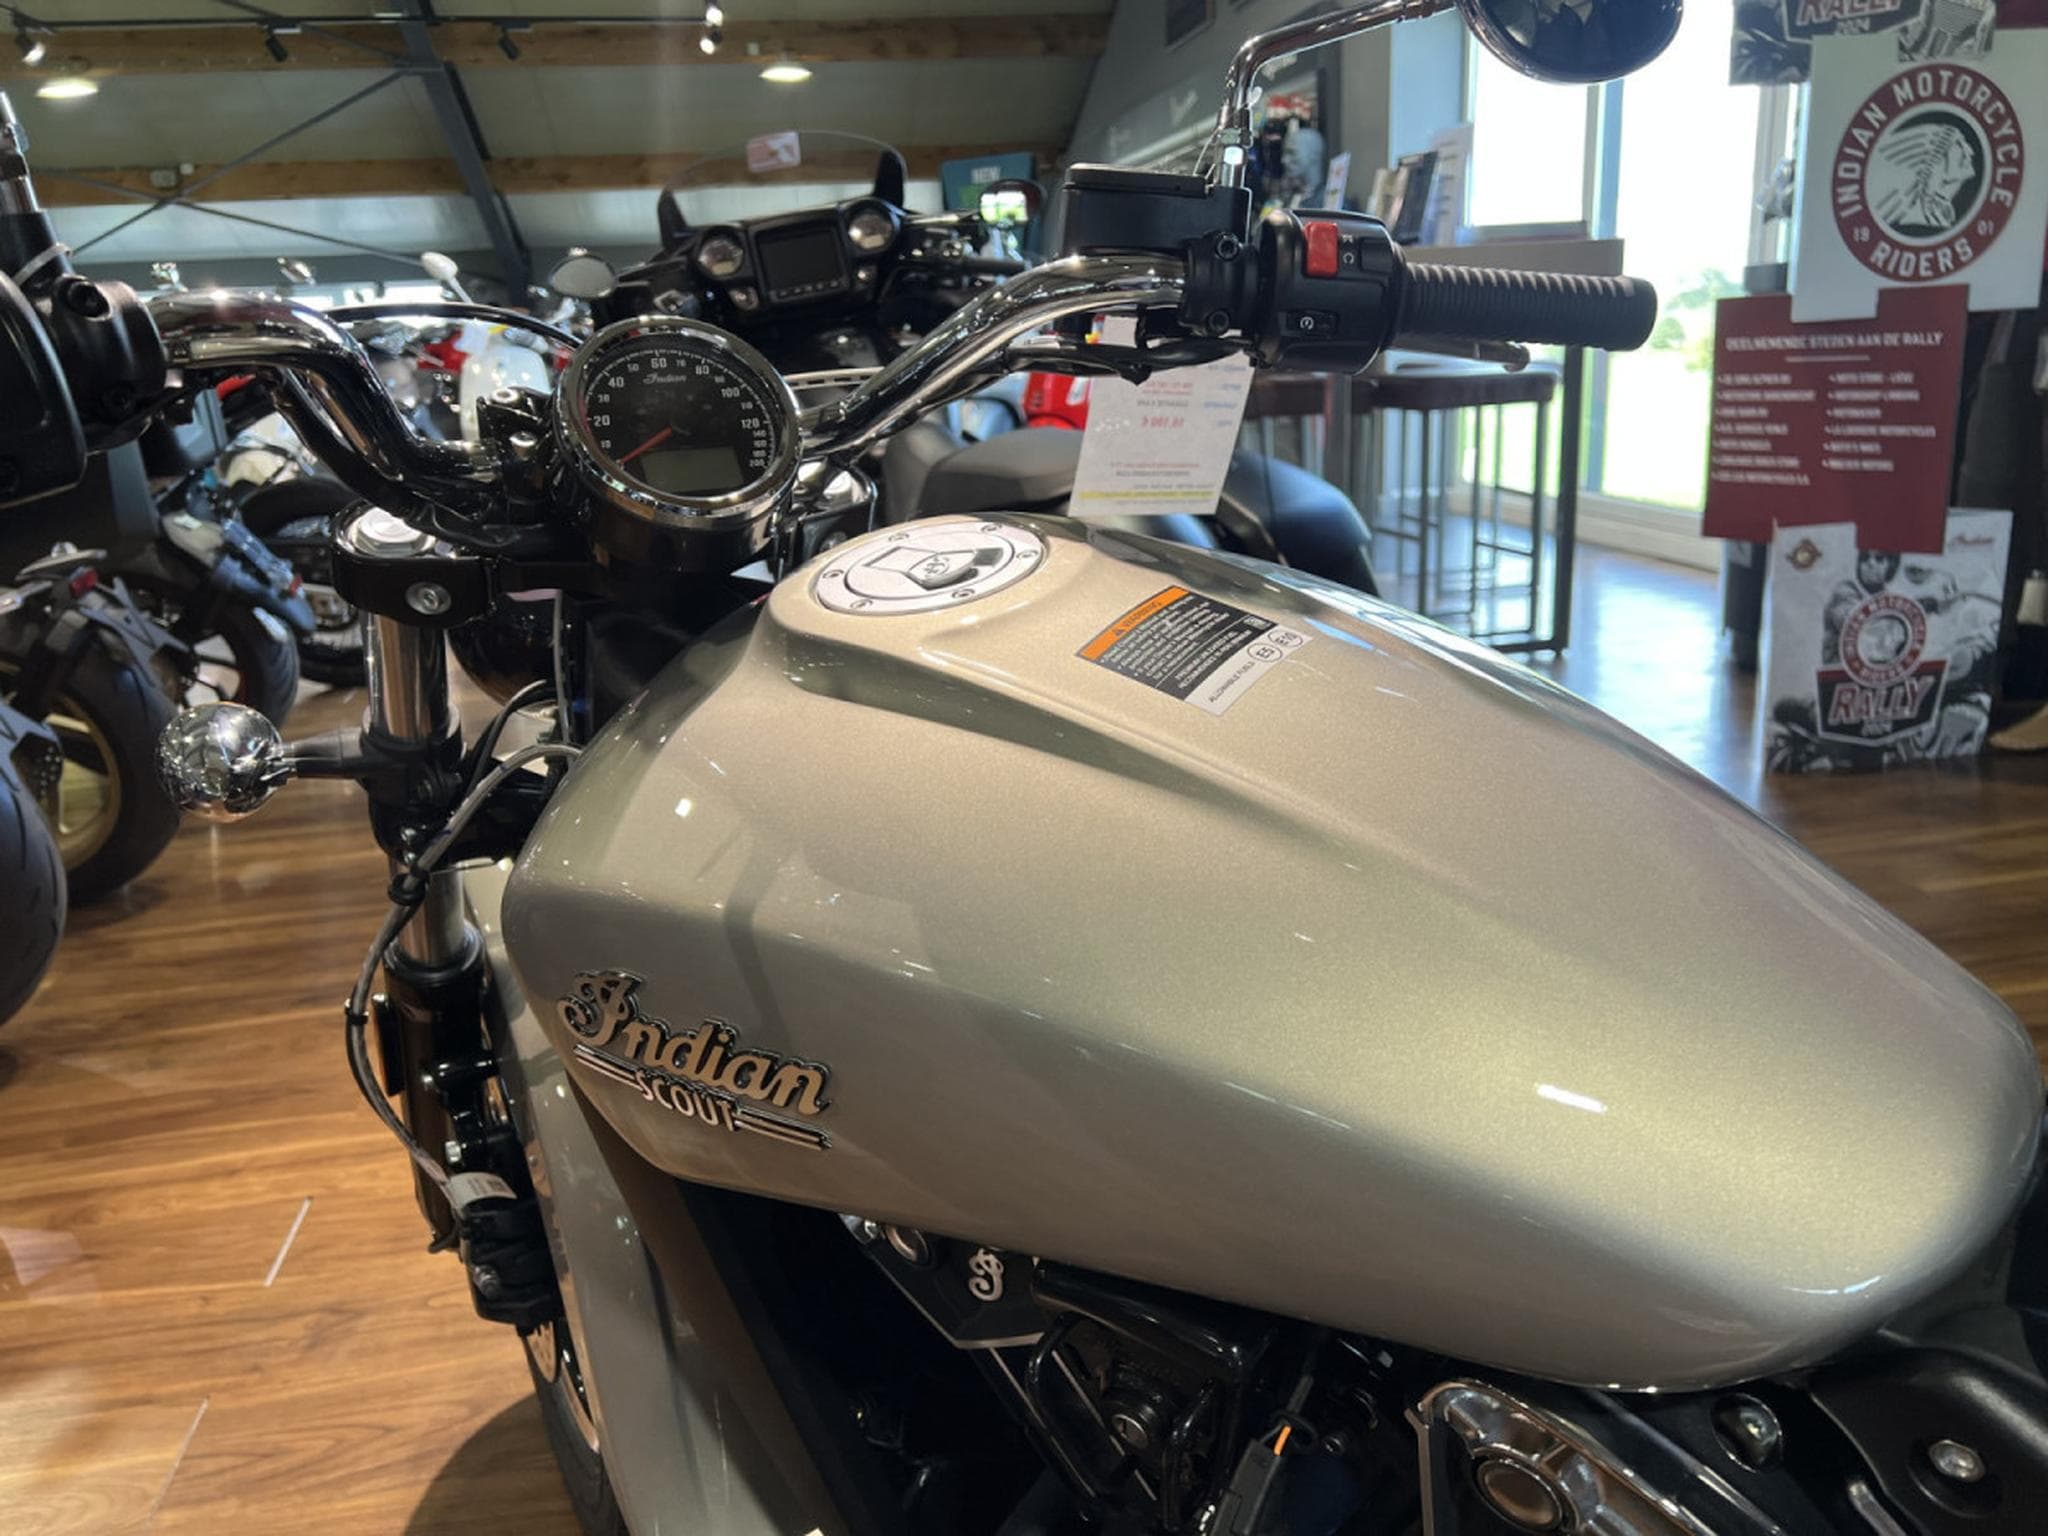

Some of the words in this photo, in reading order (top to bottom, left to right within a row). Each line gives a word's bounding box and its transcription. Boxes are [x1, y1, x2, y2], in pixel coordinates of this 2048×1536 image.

[1838, 102, 1888, 218] INDIAN
[1892, 70, 2020, 208] MOTORCYCLE
[1870, 239, 1973, 278] RIDERS
[1902, 331, 1944, 345] RALLY
[608, 376, 624, 388] 40
[721, 387, 740, 398] 100
[593, 415, 610, 427] 20
[741, 418, 760, 429] 120
[1256, 646, 1276, 660] E5
[1828, 675, 1935, 726] RALLY
[557, 969, 832, 1116] Indian
[635, 1069, 738, 1132] SCOUT
